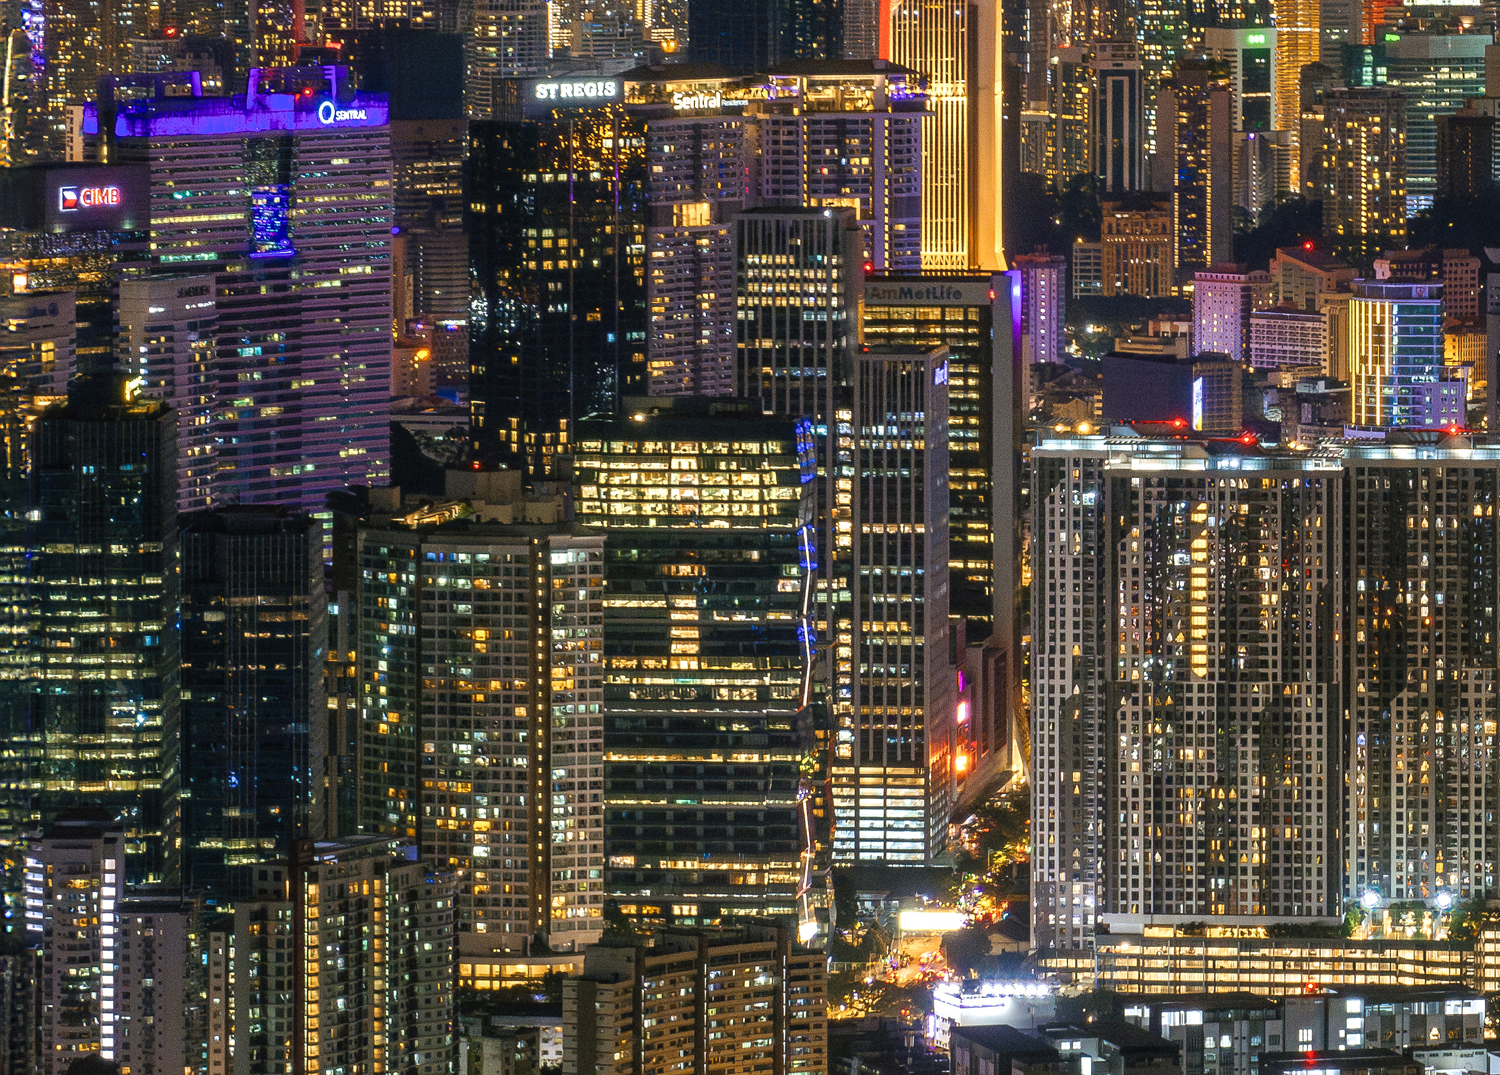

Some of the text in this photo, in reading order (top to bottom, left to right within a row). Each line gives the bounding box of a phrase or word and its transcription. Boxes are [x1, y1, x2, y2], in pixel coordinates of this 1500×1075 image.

[535, 81, 617, 99] ST REGIS
[673, 91, 721, 110] Sentral
[318, 100, 367, 125] Q SENTRAL
[80, 187, 120, 206] CIMB
[870, 284, 963, 301] AmMetLife
